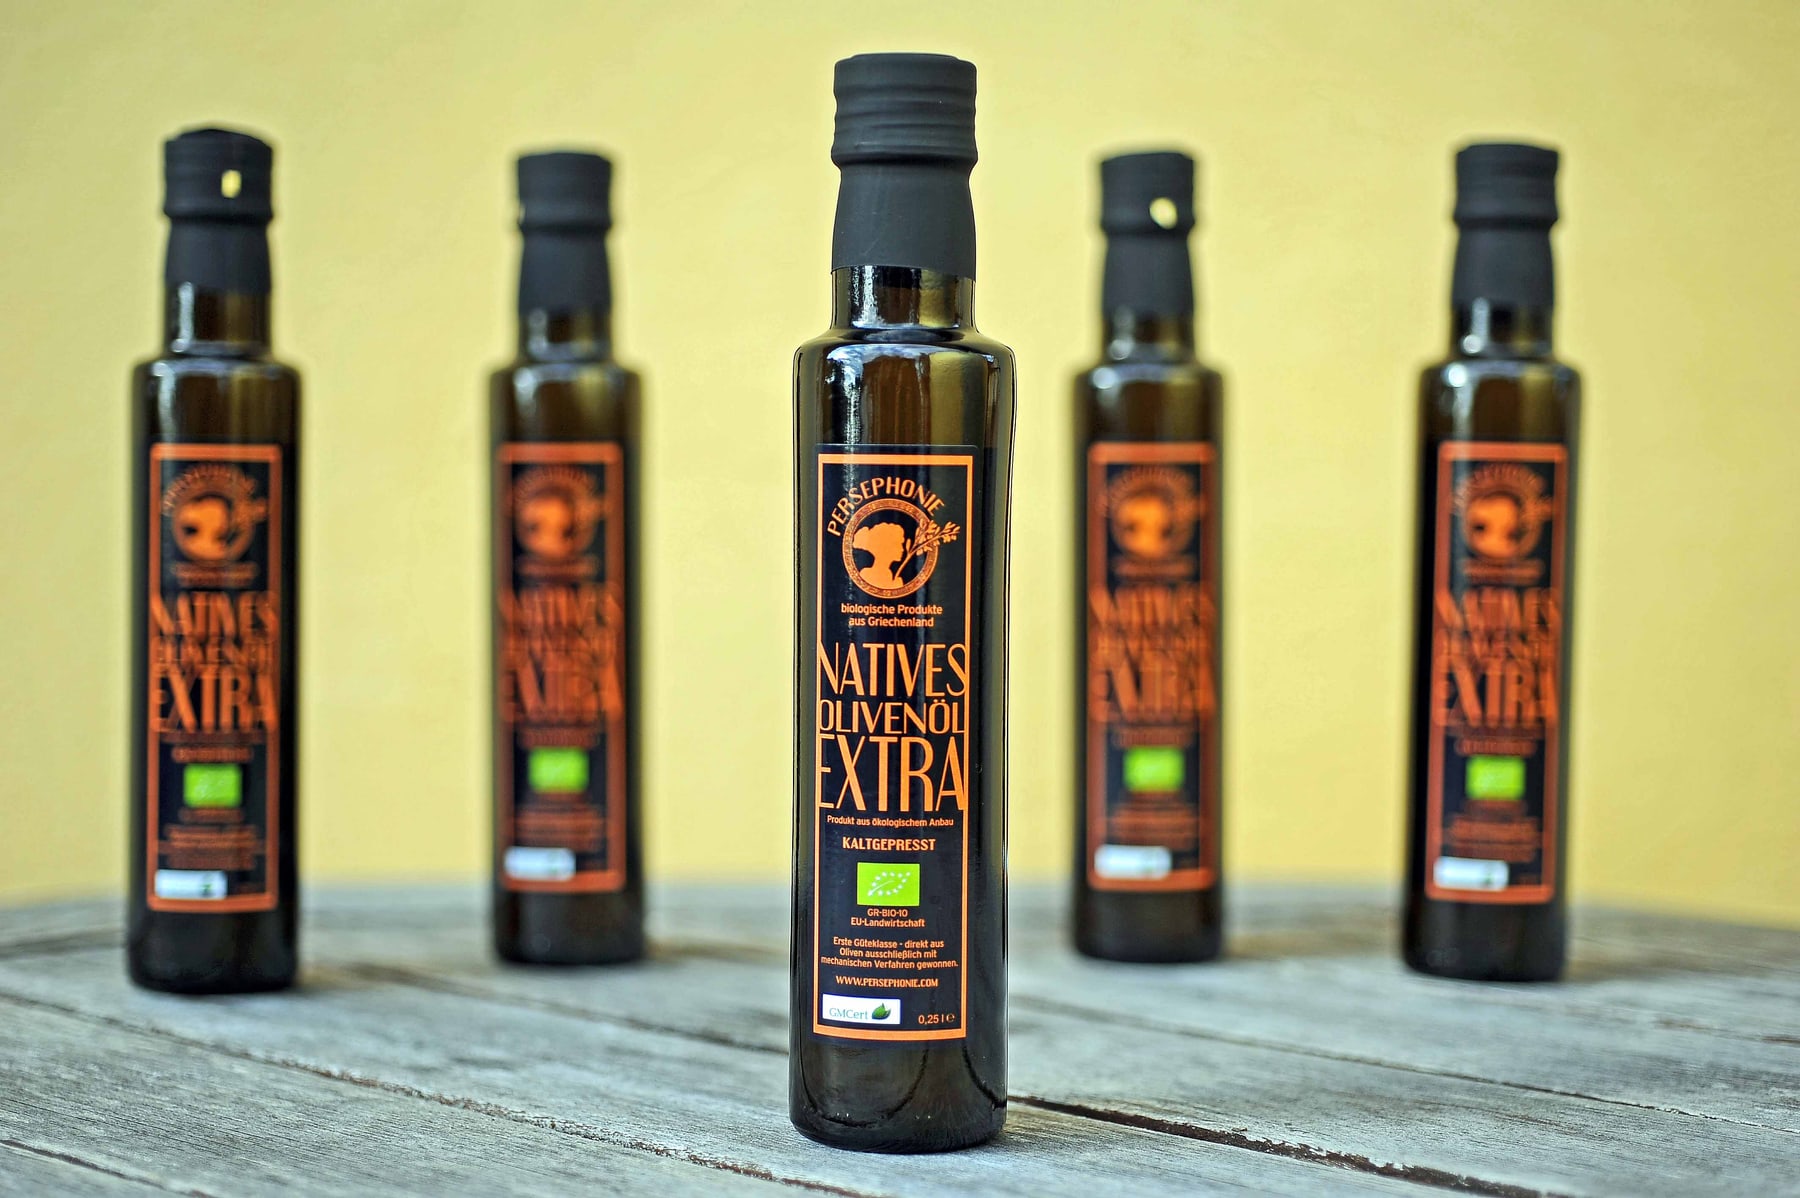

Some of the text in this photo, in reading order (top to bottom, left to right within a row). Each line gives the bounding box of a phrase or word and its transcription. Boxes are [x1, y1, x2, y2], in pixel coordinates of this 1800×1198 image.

[827, 476, 945, 537] PERSEPHONIE
[841, 603, 943, 616] biologische Produkte
[848, 617, 934, 628] aus Griechenland
[816, 641, 969, 697] NATIVES
[818, 699, 966, 734] OLIVENÖL
[816, 733, 968, 812] EXTRA
[827, 815, 954, 829] Produkt aus ökologischem Anbau
[842, 836, 936, 851] KALTGEPRESST
[867, 908, 908, 918] GR-BIO-10
[851, 917, 925, 928] EU-Landwirtschaft
[833, 936, 852, 946] Erste
[854, 938, 897, 949] Güteklasse
[905, 939, 928, 949] direkt
[930, 940, 944, 948] aus
[840, 948, 937, 960] Oliven ausschließlich mit
[821, 956, 958, 970] mechanischen Verfahren gewonnen.
[835, 975, 939, 988] WWW.PERSEPHONIE.COM
[829, 1007, 868, 1020] GMCert
[918, 1014, 939, 1026] 0,25
